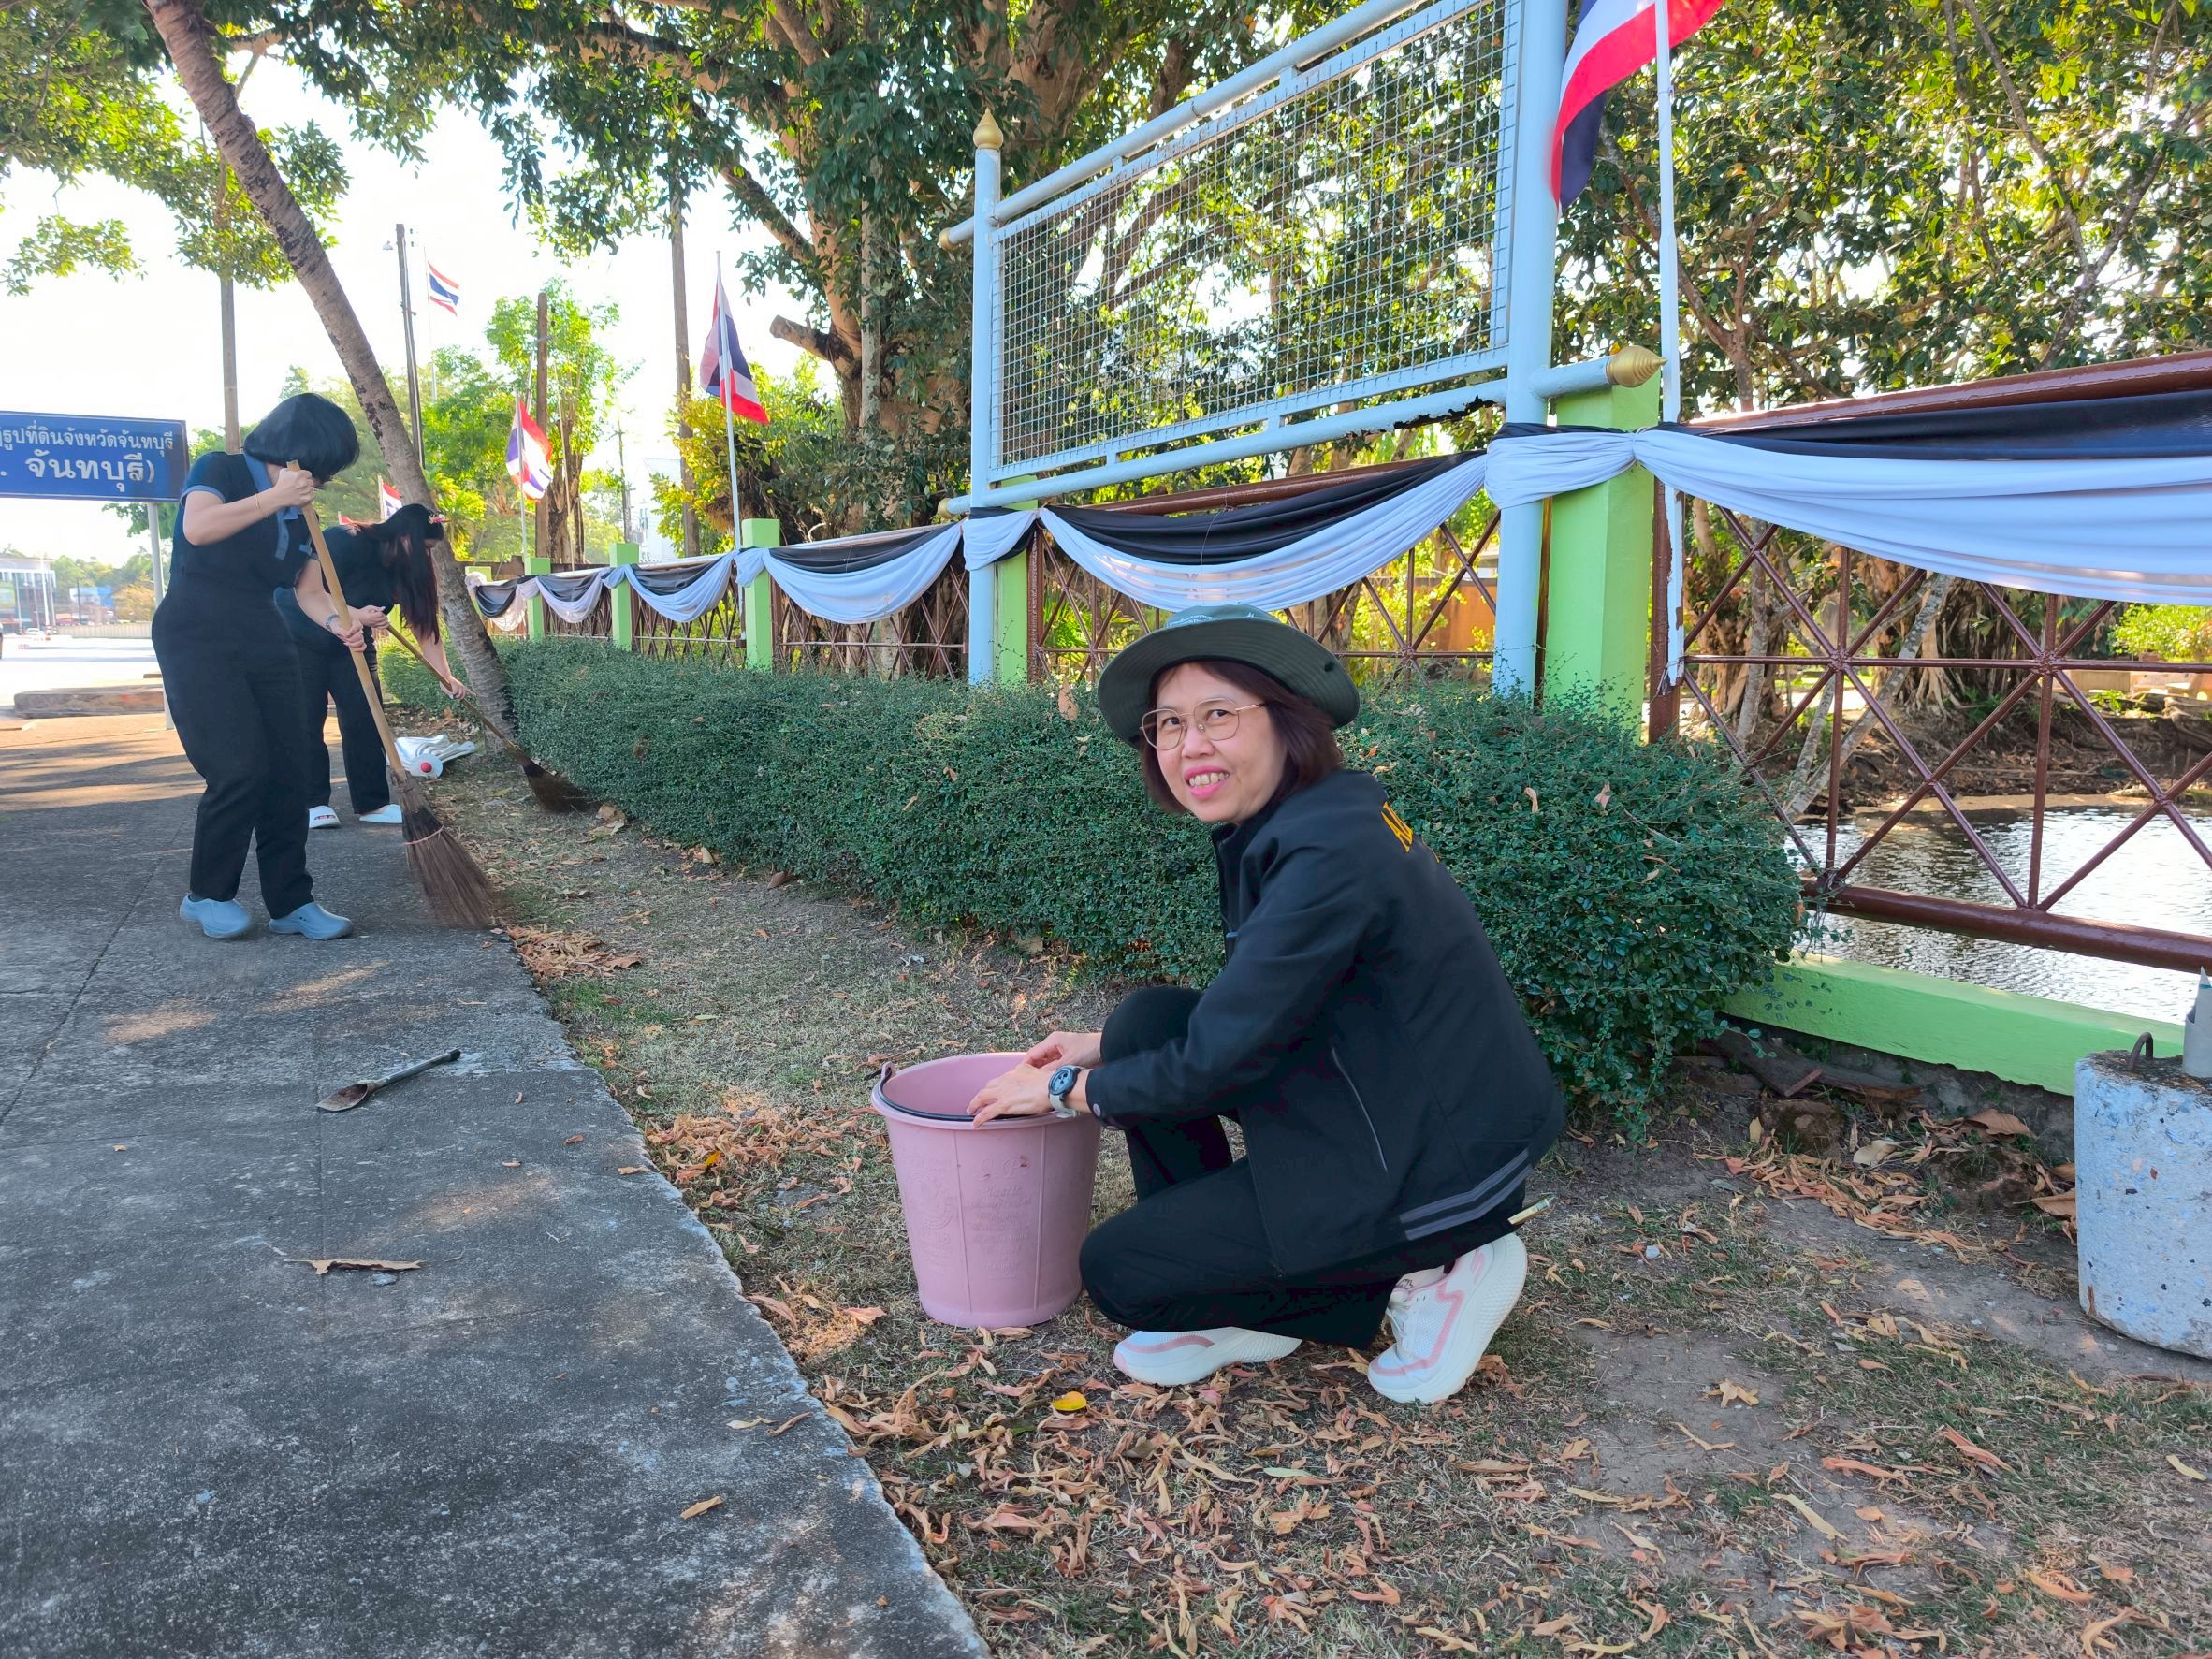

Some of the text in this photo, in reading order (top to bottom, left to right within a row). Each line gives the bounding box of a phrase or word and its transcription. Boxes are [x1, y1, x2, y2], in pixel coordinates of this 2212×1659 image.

[0, 420, 174, 457] รูปที่ดินจังหวัดจันทบุรี
[25, 449, 155, 493] จันทบุรี)
